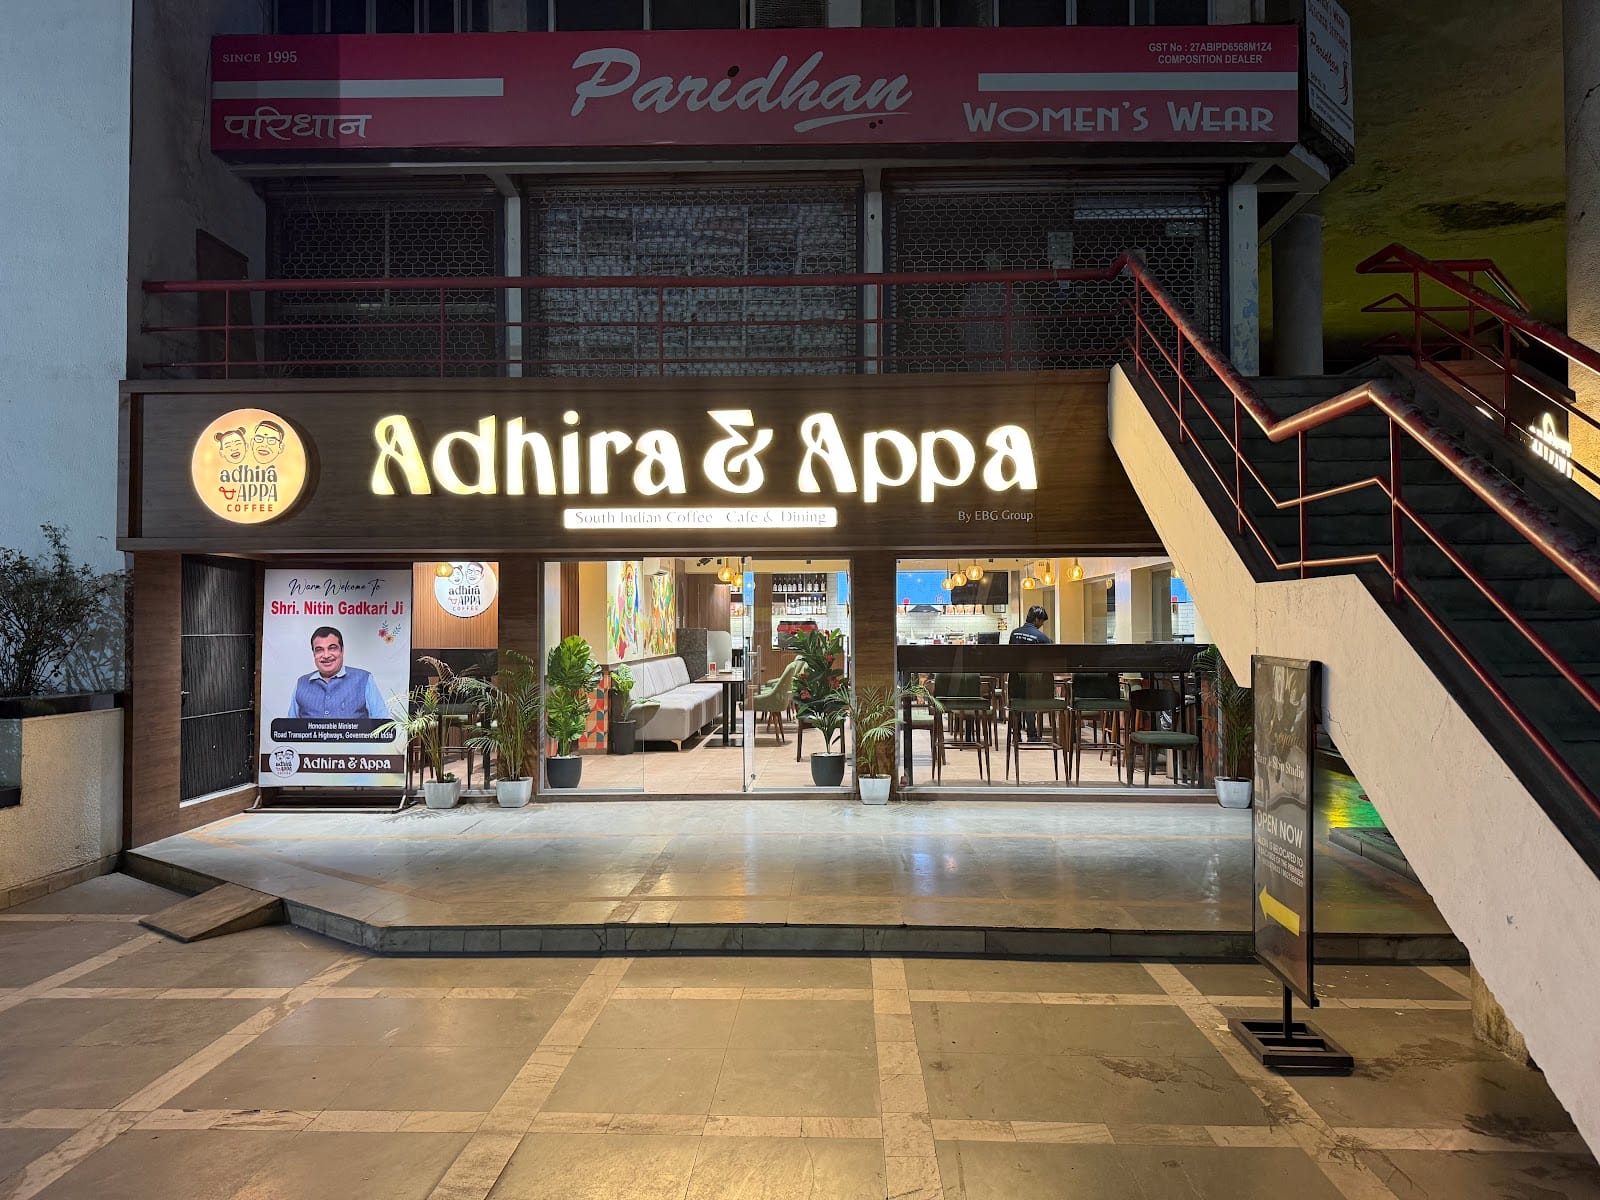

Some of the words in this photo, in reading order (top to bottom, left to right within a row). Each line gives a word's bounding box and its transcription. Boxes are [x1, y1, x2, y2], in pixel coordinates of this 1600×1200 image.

[1148, 42, 1168, 52] GST
[1169, 42, 1183, 52] No
[222, 53, 261, 63] SINCE
[267, 51, 298, 64] 1995
[1157, 54, 1223, 64] COMPOSITION
[1224, 53, 1264, 64] DEALER
[570, 48, 913, 118] Paridhan
[223, 106, 373, 141] परिधान
[962, 101, 1150, 133] WOMEN'S
[1167, 101, 1275, 132] WEAR
[370, 409, 688, 496] Adhira
[703, 409, 774, 494] &
[798, 412, 1038, 503] Appa
[236, 483, 278, 502] APPA
[226, 503, 274, 513] COFFEE
[574, 511, 615, 524] South
[620, 511, 661, 524] Indian
[666, 510, 713, 524] Coffee
[763, 510, 774, 522] &
[781, 509, 827, 525] Dining
[957, 510, 972, 523] By
[975, 510, 999, 521] EBG
[1001, 510, 1034, 523] Group
[288, 578, 321, 597] Warm
[323, 578, 366, 597] Welcome
[367, 578, 385, 597] To
[271, 601, 300, 616] Shri.
[303, 601, 334, 616] Nitin
[338, 601, 388, 616] Gadkari
[391, 601, 404, 616] Ji
[338, 722, 359, 730] Minister
[288, 731, 312, 740] Transport
[303, 756, 346, 770] Adhira
[348, 756, 358, 769] &
[359, 757, 392, 771] Appa
[1285, 761, 1305, 780] Studio
[1256, 808, 1278, 836] OPEN
[1279, 819, 1304, 849] NOW
